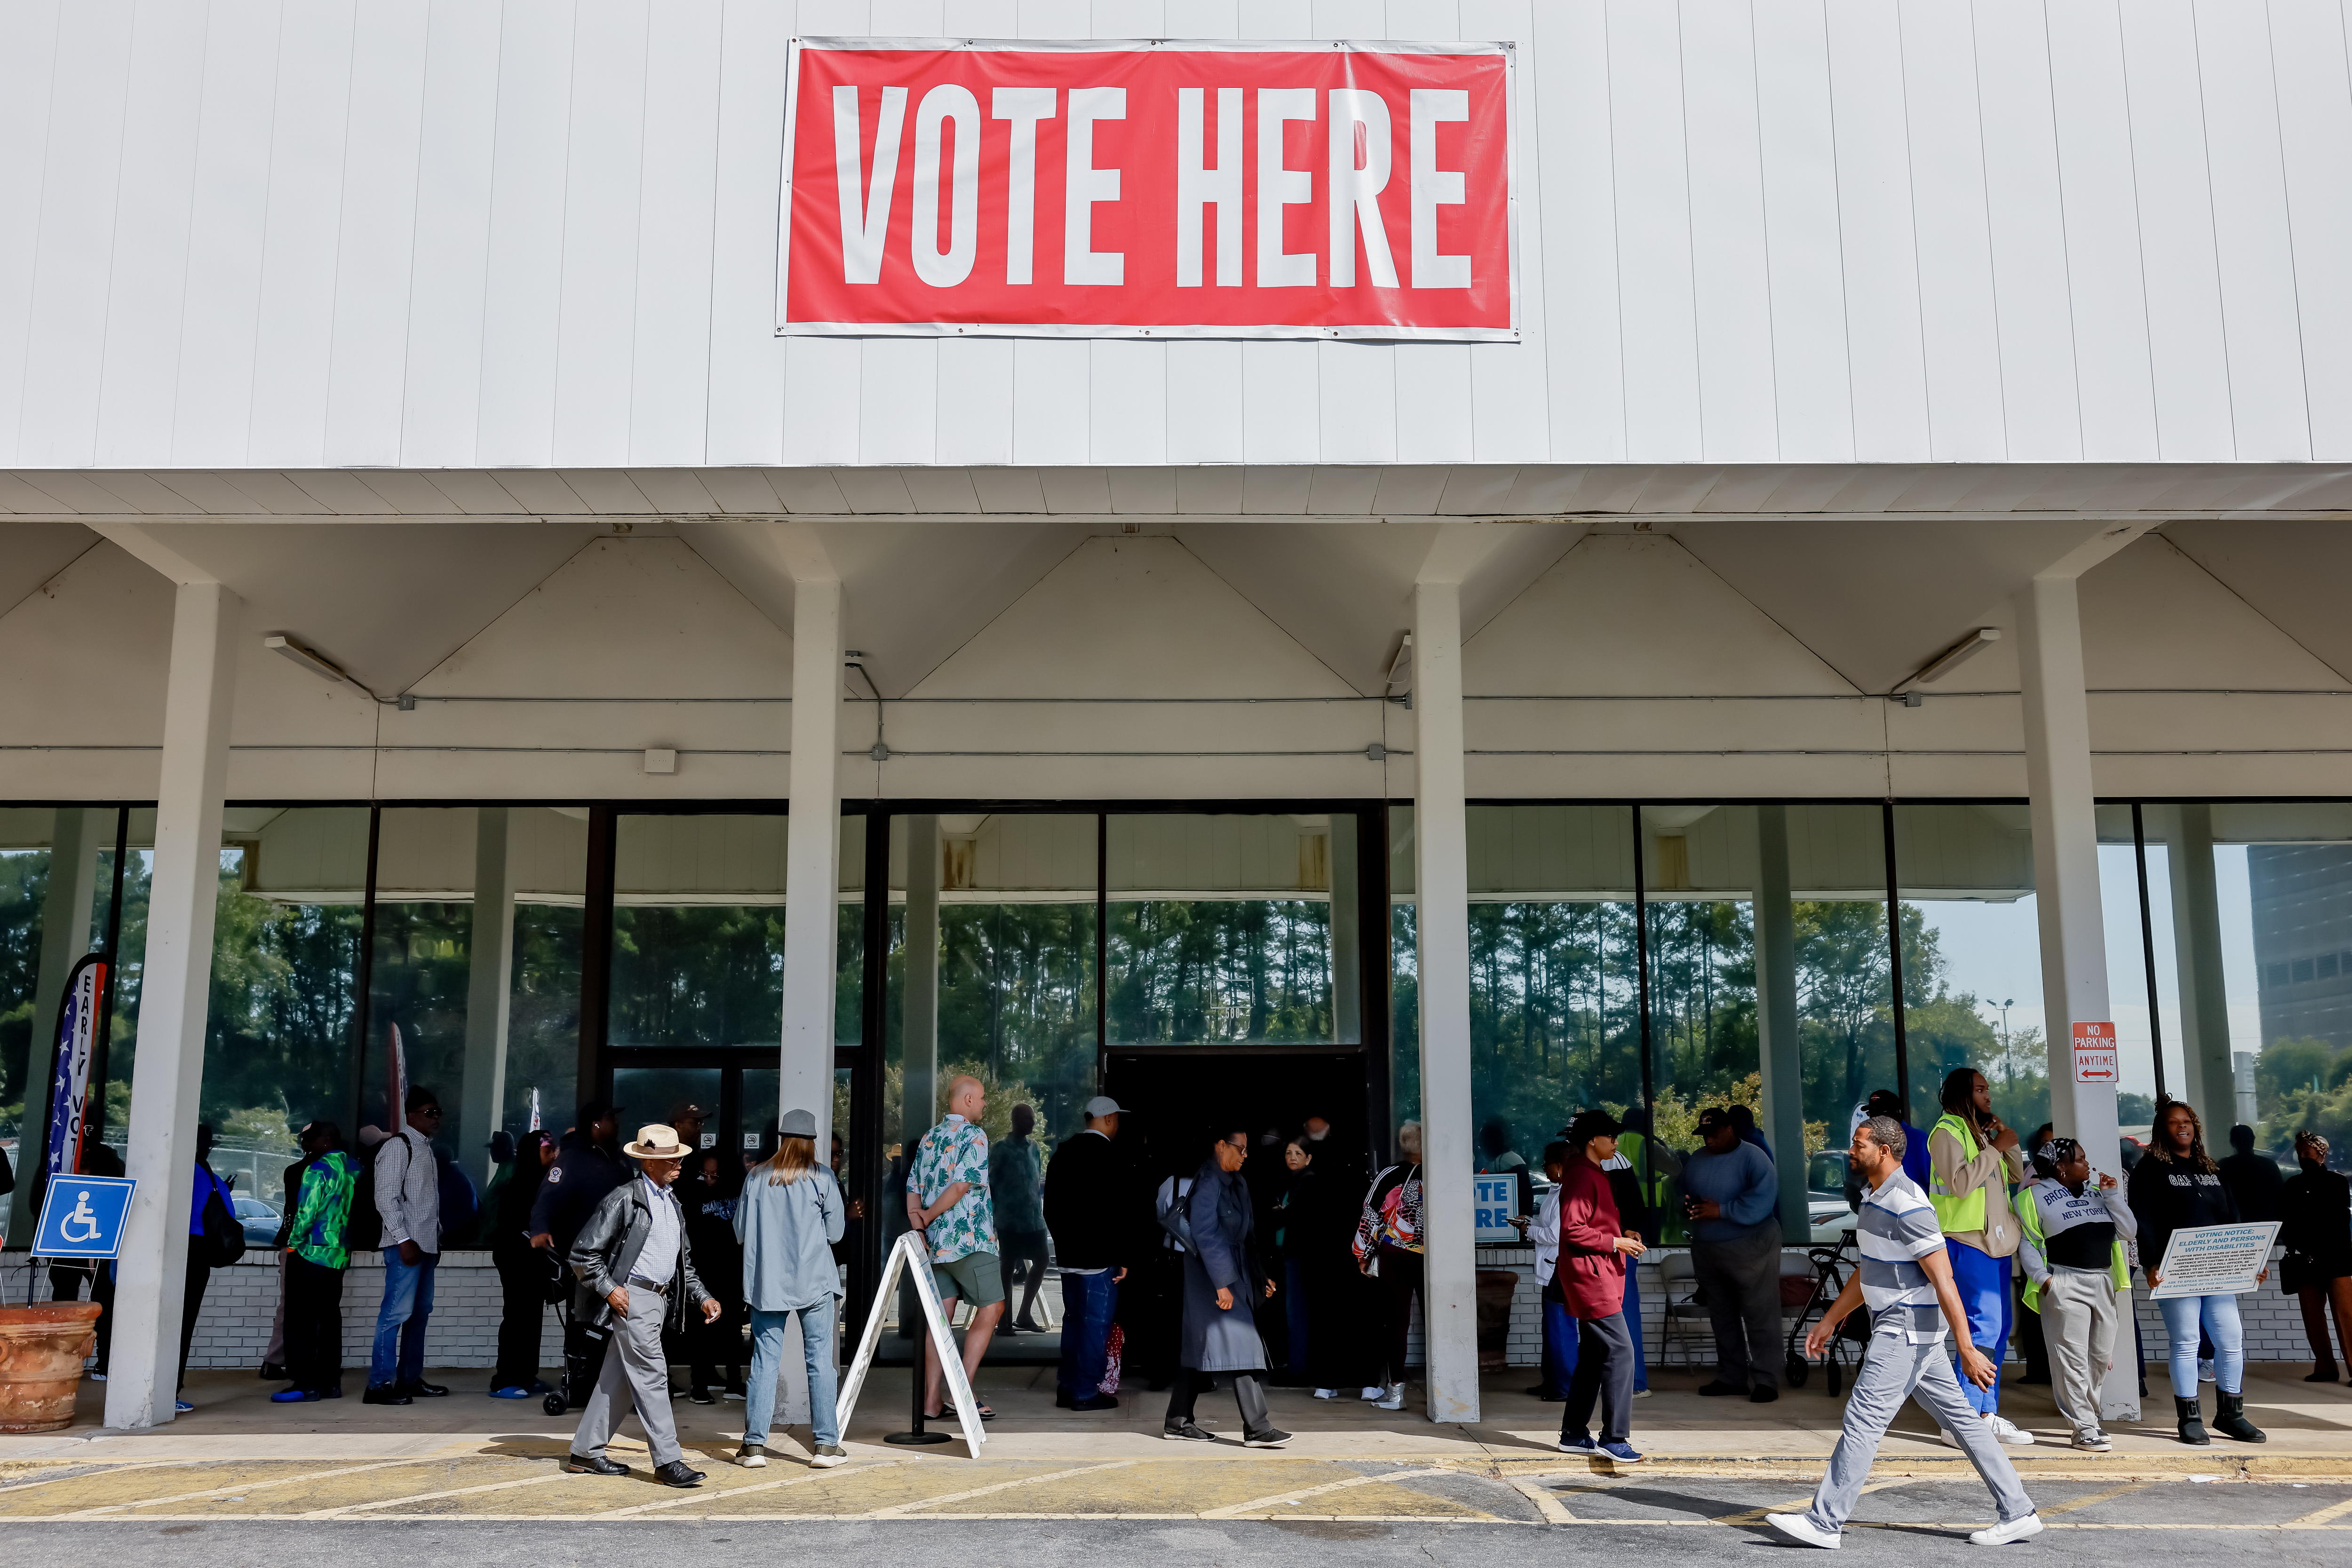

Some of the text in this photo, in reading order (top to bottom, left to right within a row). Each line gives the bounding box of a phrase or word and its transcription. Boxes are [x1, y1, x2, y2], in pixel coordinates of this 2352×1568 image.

[832, 84, 1472, 289] VOTE HERE
[1225, 1007, 1240, 1019] 500
[77, 975, 91, 1076] EARLY
[2087, 1025, 2100, 1036] NO
[2074, 1037, 2115, 1048] PARKING
[2079, 1056, 2114, 1066] ANYTIME
[70, 1095, 84, 1174] VOT
[1474, 1182, 1508, 1202] TE
[702, 1202, 722, 1212] GRAND
[1475, 1208, 1508, 1228] RE
[2062, 1207, 2106, 1220] NEW YORK
[2206, 1242, 2255, 1251] DISABILITIES
